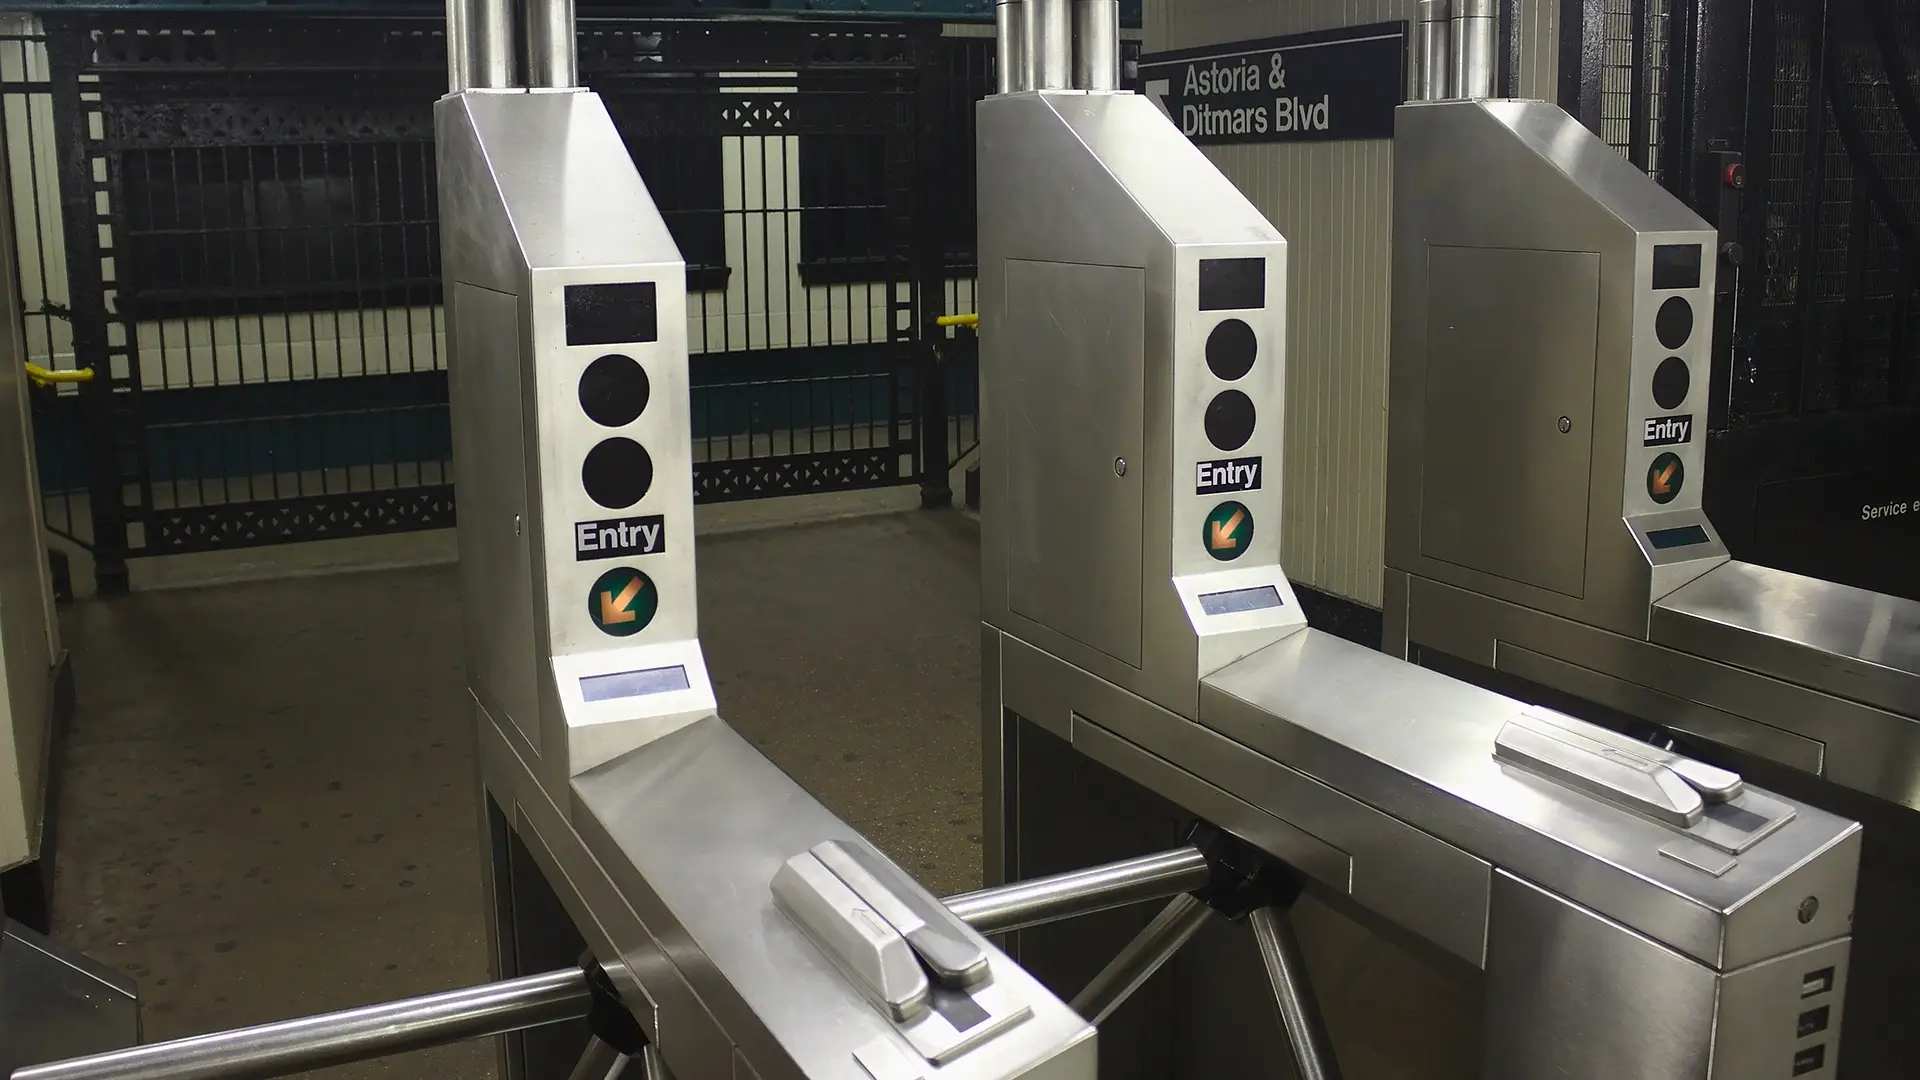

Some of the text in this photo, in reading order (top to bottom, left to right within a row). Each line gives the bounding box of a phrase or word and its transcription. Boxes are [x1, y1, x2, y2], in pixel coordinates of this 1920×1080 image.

[1183, 52, 1285, 96] Astoria &
[1183, 94, 1329, 137] Ditmars Blvd
[1644, 419, 1689, 442] Entry
[1196, 461, 1258, 488] Entry
[1862, 501, 1907, 520] Service
[577, 522, 660, 552] Entry
